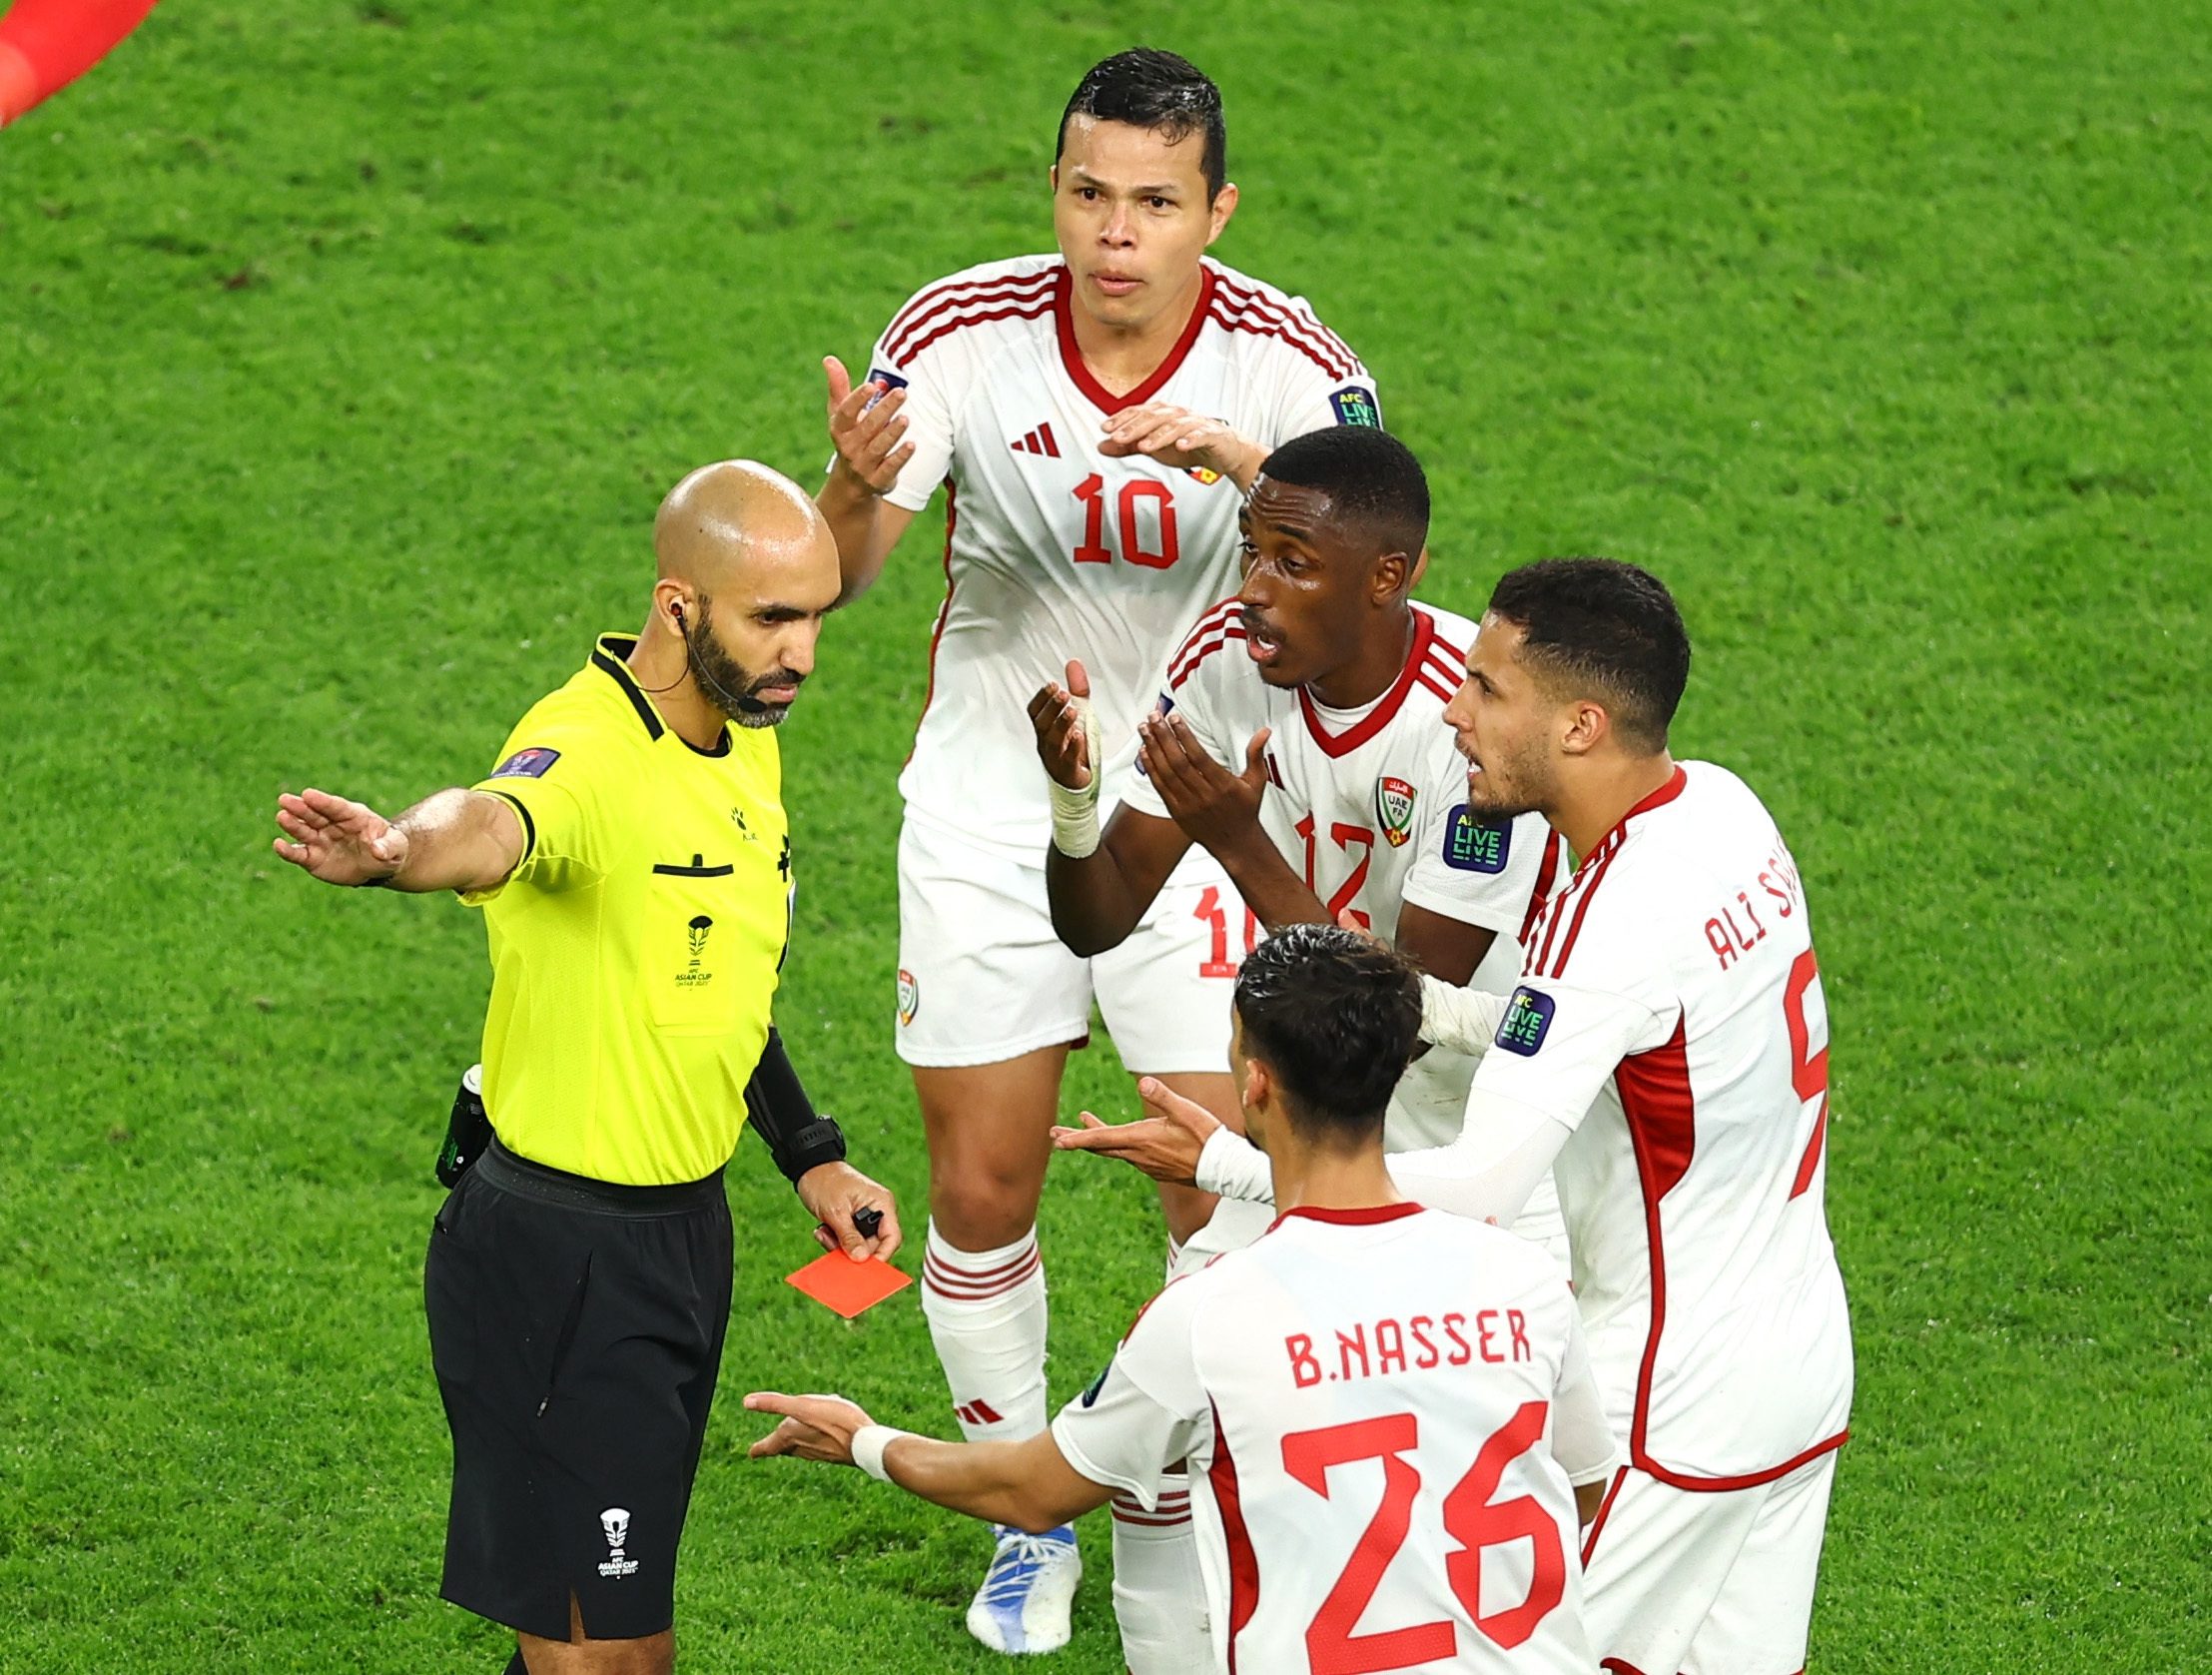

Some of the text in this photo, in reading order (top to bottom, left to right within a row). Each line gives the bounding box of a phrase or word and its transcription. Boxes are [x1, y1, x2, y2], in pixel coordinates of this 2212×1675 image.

[1339, 393, 1363, 404] AFC
[1072, 472, 1179, 570] 10
[1388, 795, 1408, 811] UAE
[1392, 806, 1404, 819] FA
[1454, 826, 1502, 848] LIVE
[1294, 809, 1375, 930] 12
[1193, 885, 1256, 978] 1
[1705, 892, 1767, 971] ALI
[1507, 1005, 1544, 1031] LIVE
[1284, 1308, 1531, 1388] B.NASSER
[1280, 1400, 1566, 1675] 26
[597, 1562, 623, 1571] ASIAN
